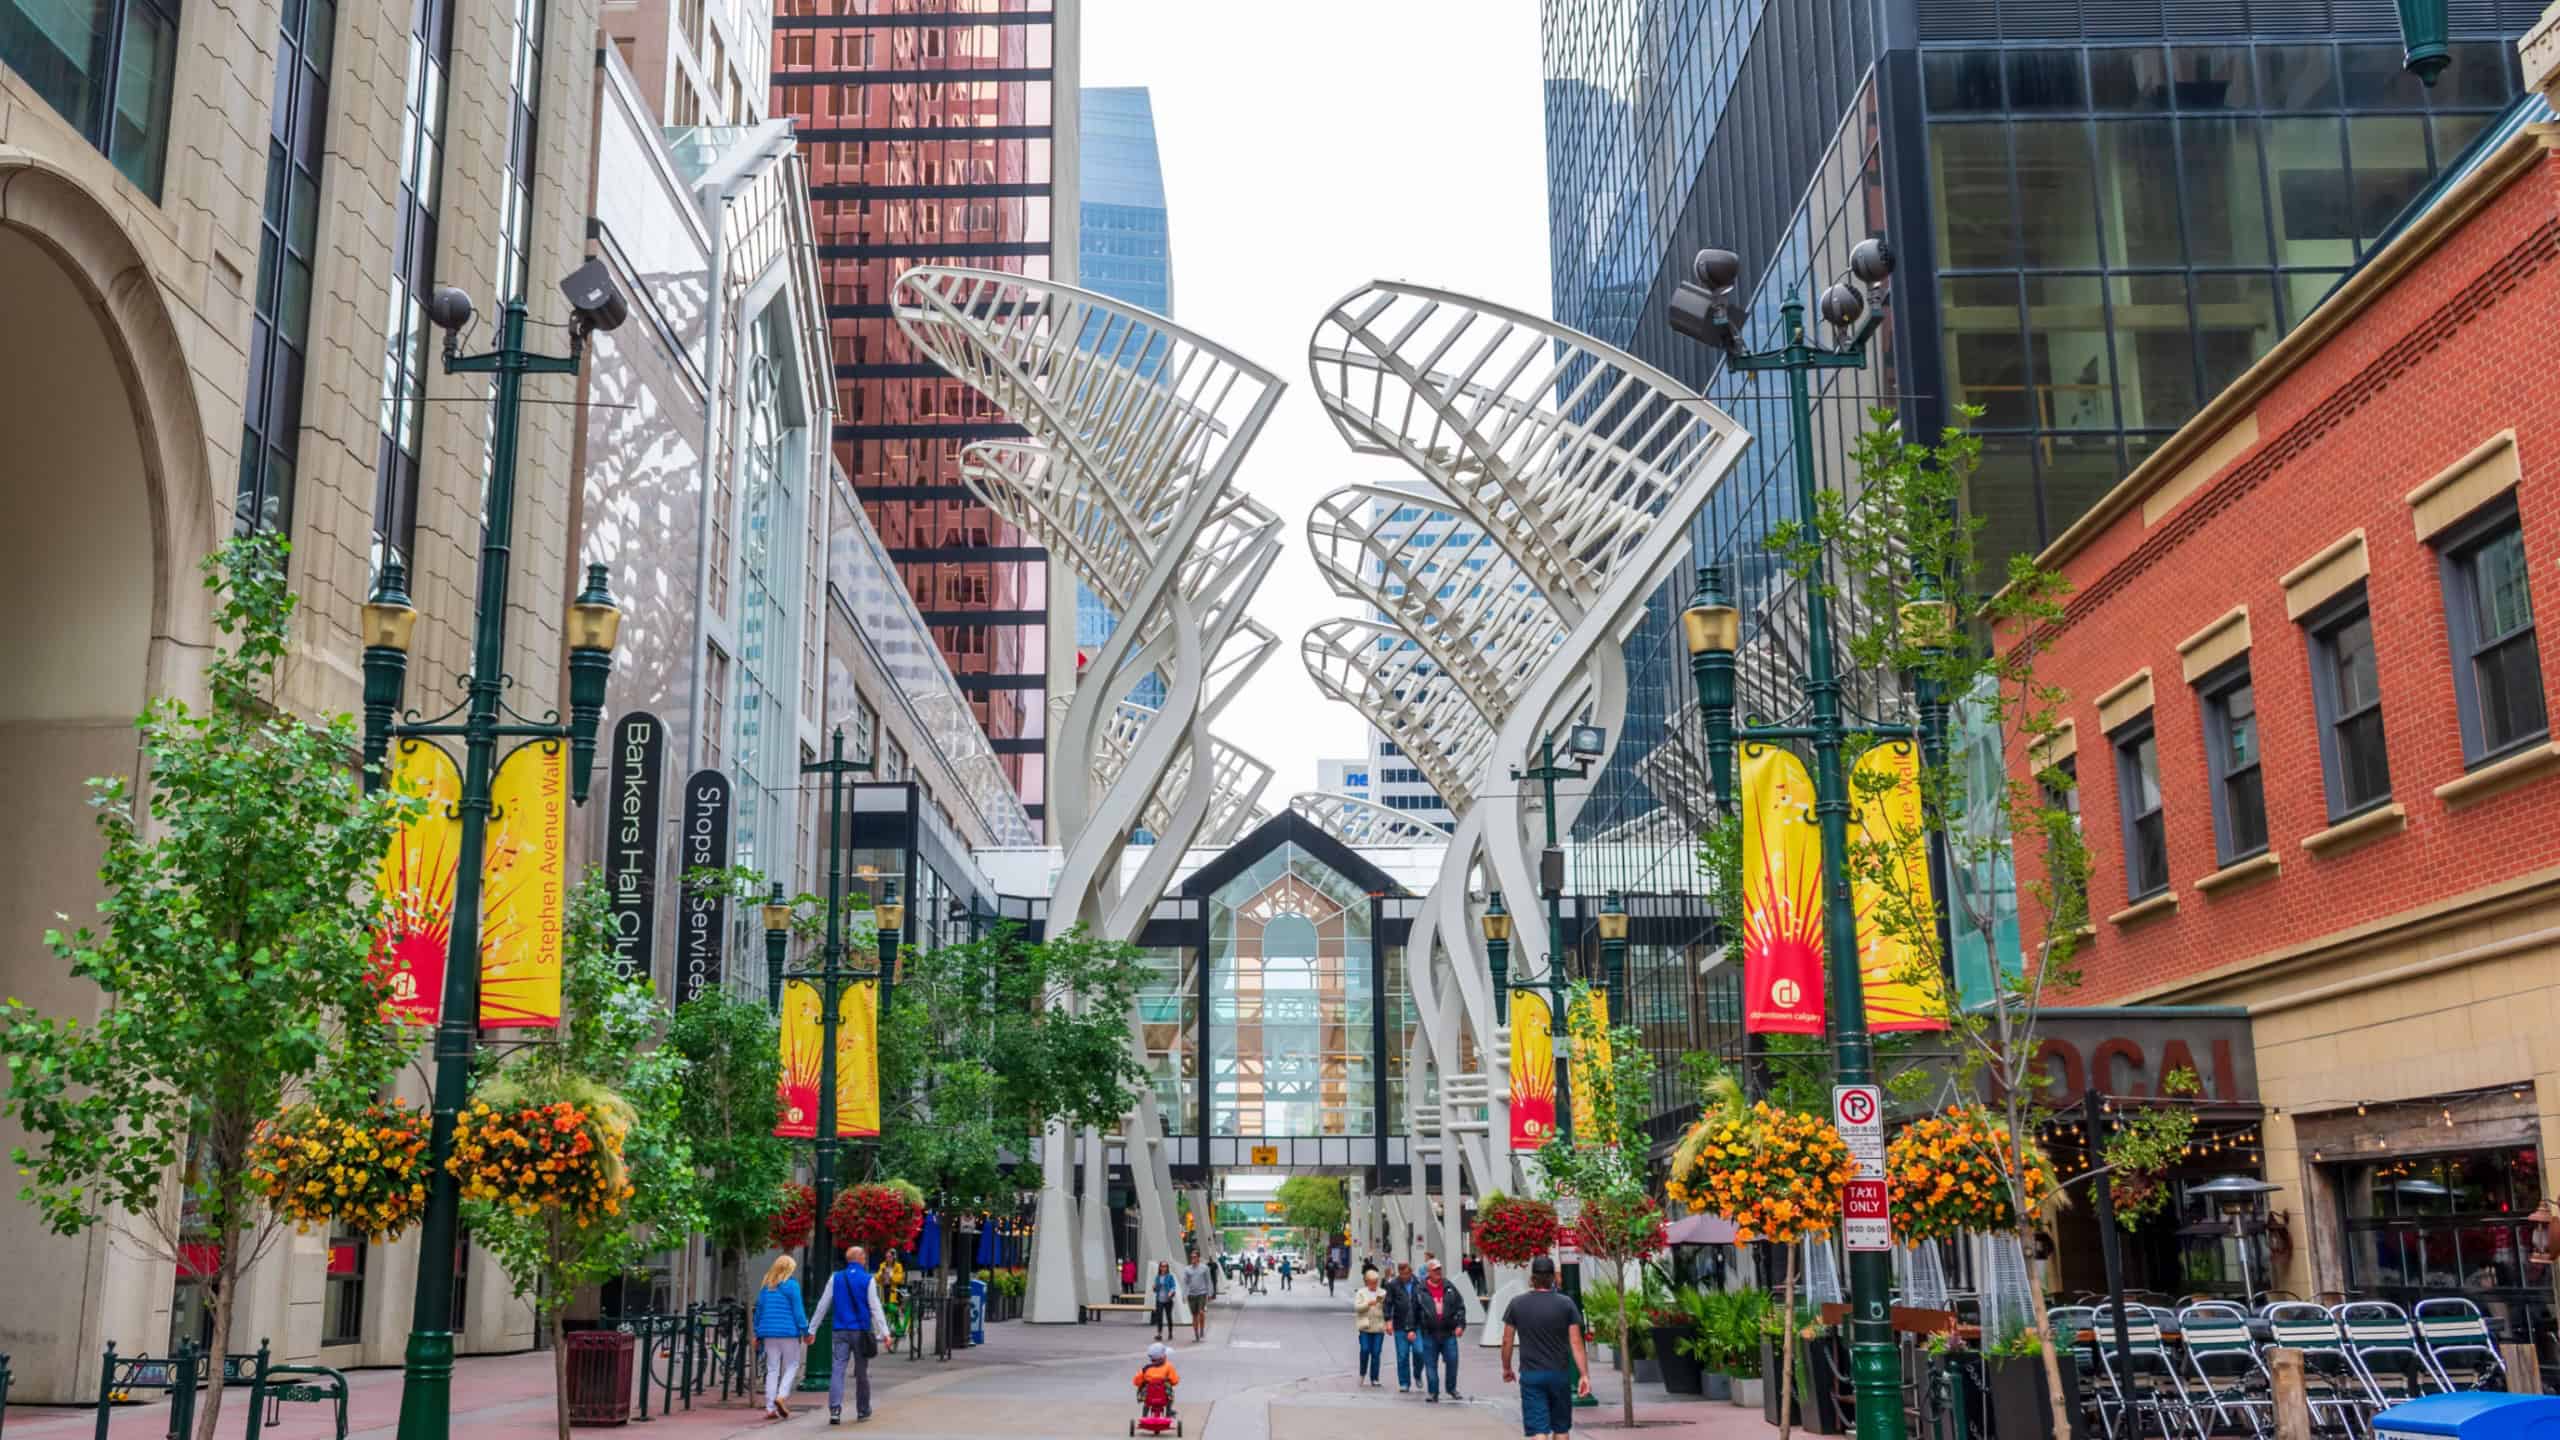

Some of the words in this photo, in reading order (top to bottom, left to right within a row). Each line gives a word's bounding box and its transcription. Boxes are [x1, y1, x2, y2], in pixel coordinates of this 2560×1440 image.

[621, 723, 650, 843] Bankers
[539, 801, 559, 874] Avenue
[689, 787, 720, 864] Shops
[618, 850, 643, 904] Hall
[536, 881, 560, 965] Stephen
[615, 911, 640, 980] Club
[688, 897, 715, 1001] Services
[1849, 1187, 1877, 1198] TAXI
[1849, 1201, 1880, 1212] ONLY
